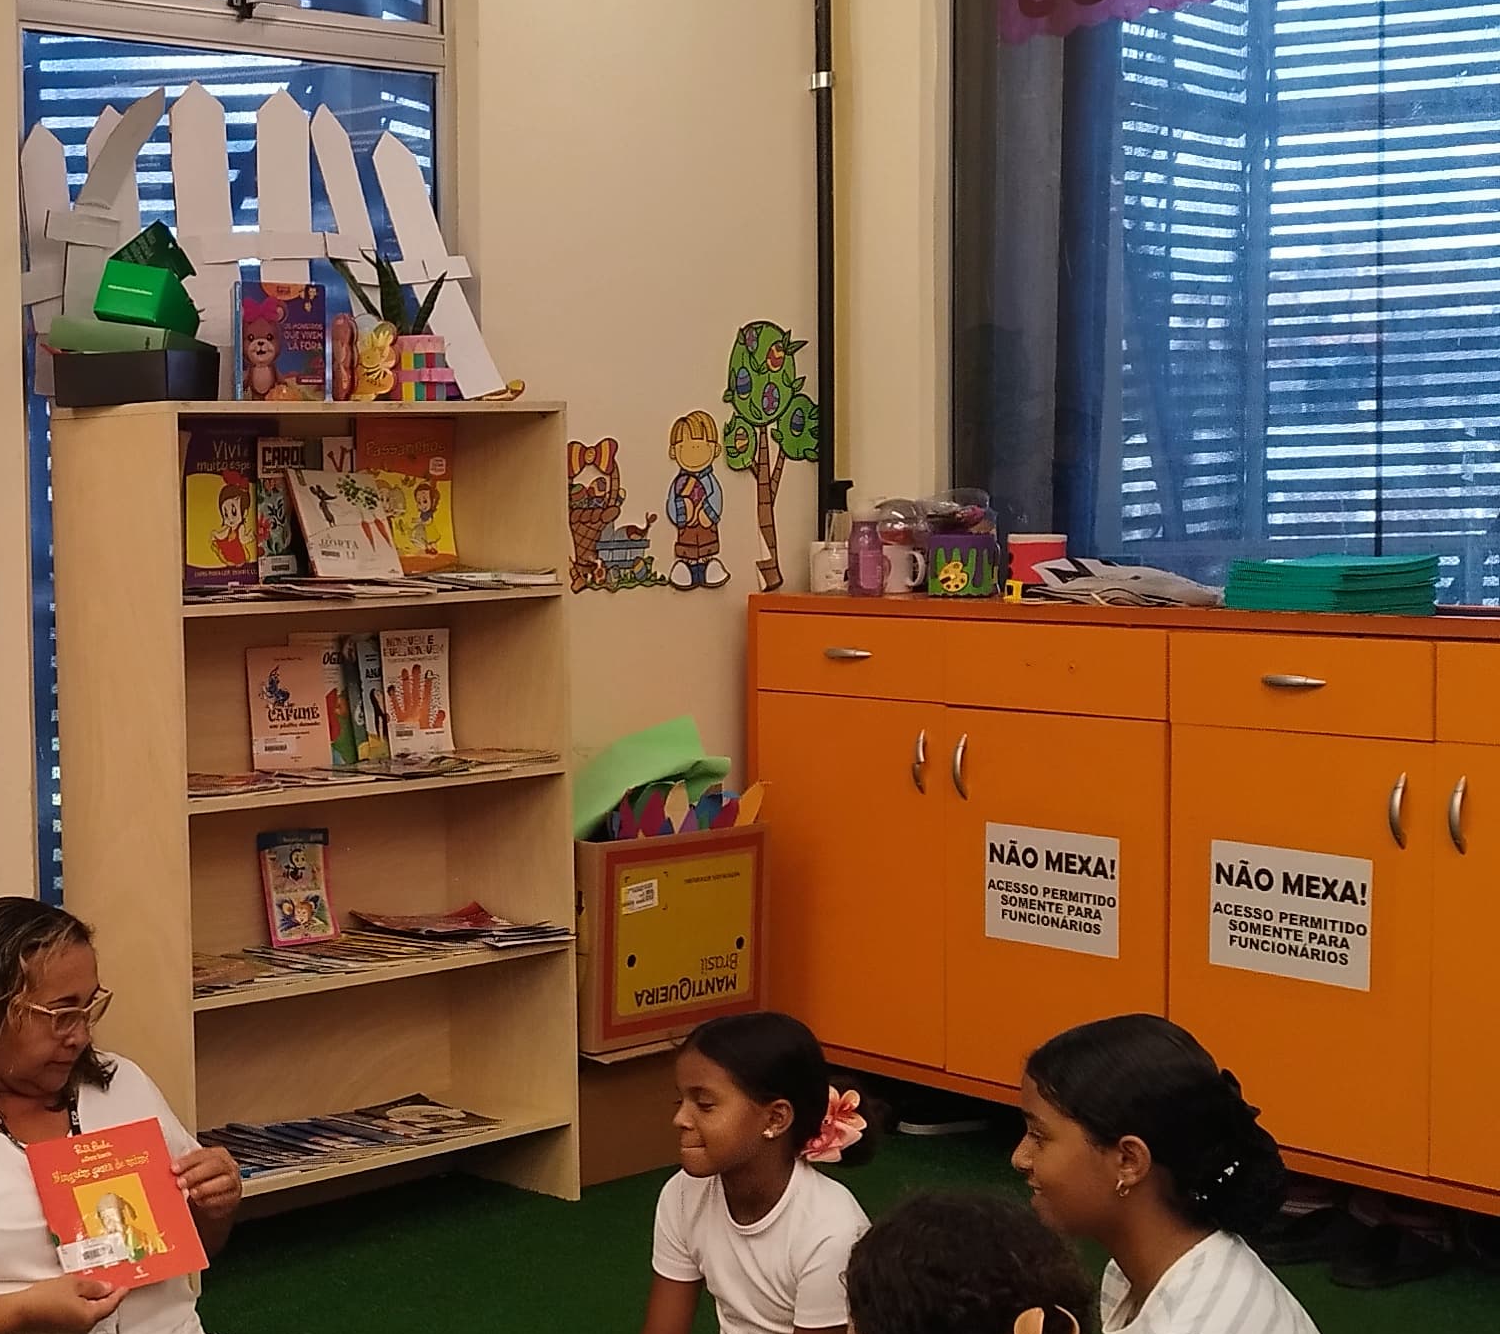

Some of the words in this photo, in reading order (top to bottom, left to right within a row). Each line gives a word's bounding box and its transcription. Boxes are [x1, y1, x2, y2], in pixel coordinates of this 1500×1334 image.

[989, 839, 1039, 869] NÃO
[1045, 850, 1116, 880] MEXA!
[988, 879, 1039, 896] ACESSO
[1042, 886, 1117, 908] PERMITIDO
[1215, 860, 1274, 891] NÃO
[1282, 871, 1367, 906] MEXA!
[1000, 894, 1063, 914] SOMENTE
[1067, 905, 1103, 921] PARA
[1001, 908, 1101, 935] FUNCIONÁRIOS
[1213, 902, 1273, 921] ACESSO
[1279, 911, 1368, 936] PERMITIDO
[1228, 919, 1303, 942] SOMENTE
[1308, 932, 1350, 950] PARA
[1229, 934, 1349, 966] FUNCIONÁRIOS
[700, 952, 739, 974] Brasil
[634, 973, 738, 1007] MANTIQUEIRA
